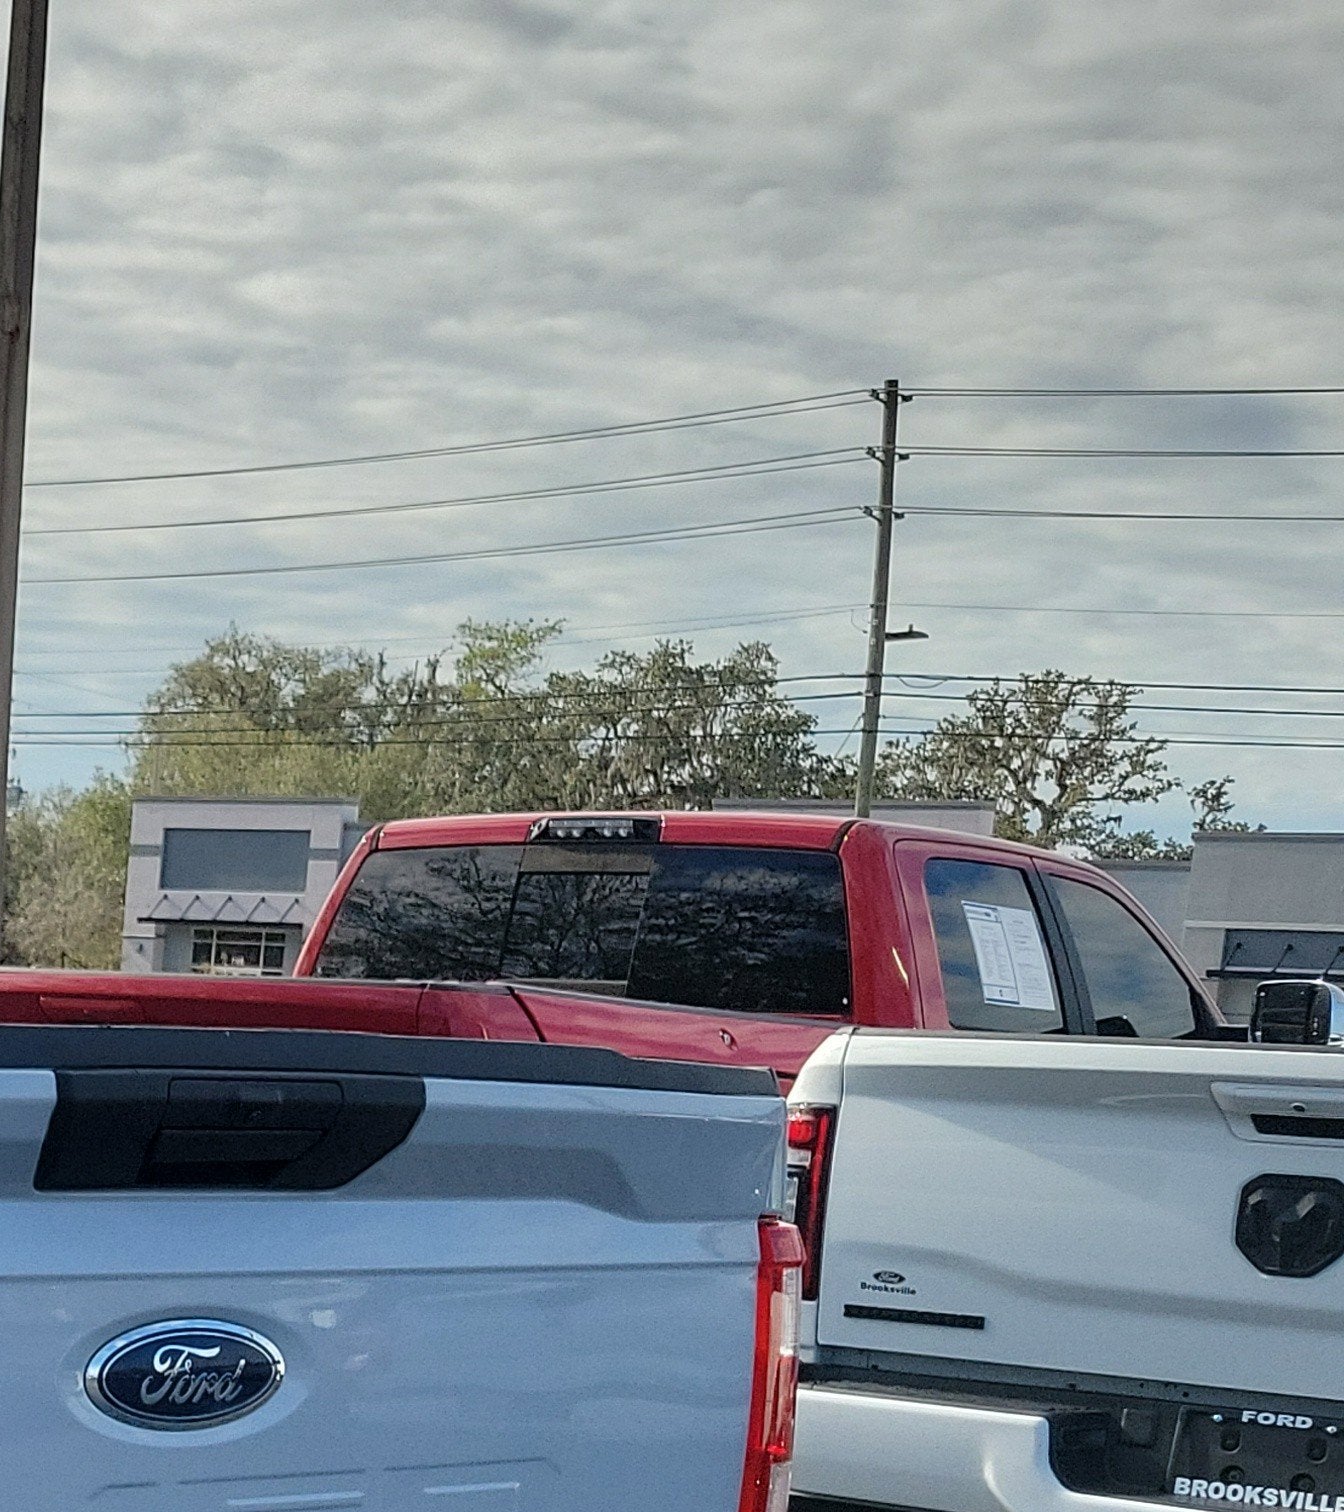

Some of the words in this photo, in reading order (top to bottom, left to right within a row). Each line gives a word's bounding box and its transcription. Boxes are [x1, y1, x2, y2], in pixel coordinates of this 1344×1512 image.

[860, 1282, 917, 1295] Brooksville
[140, 1344, 246, 1405] Ford
[1241, 1410, 1314, 1429] FORD
